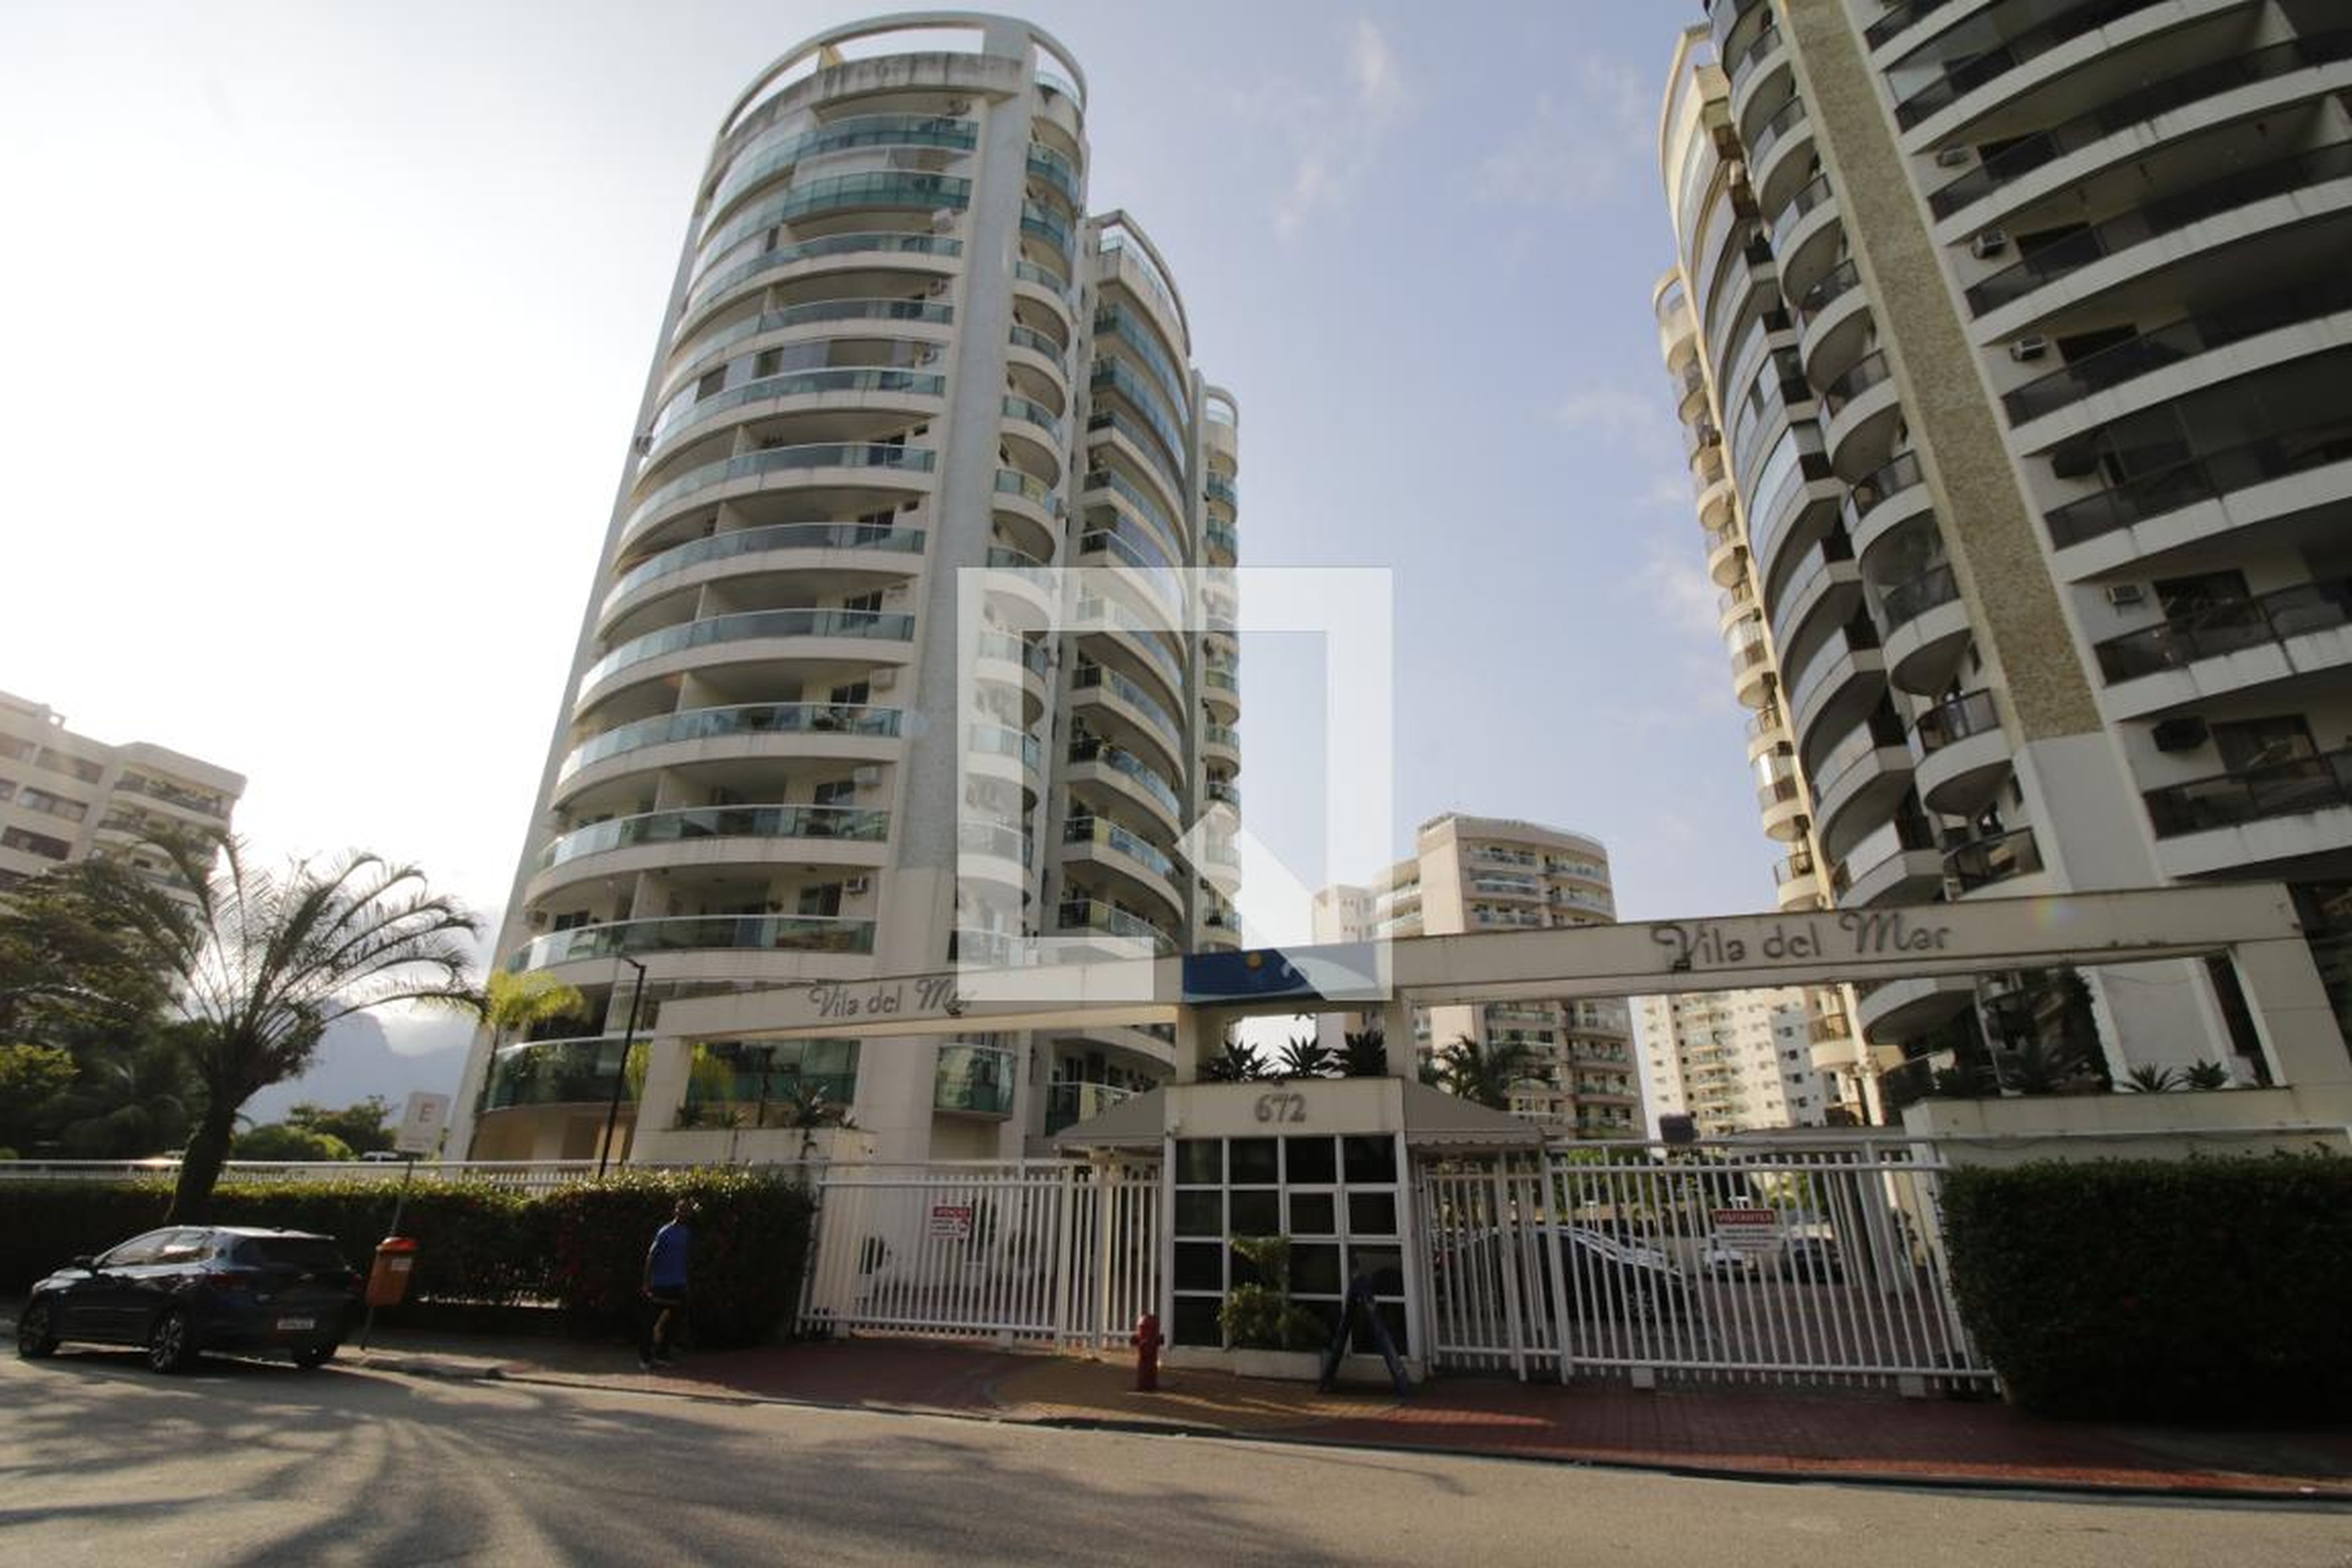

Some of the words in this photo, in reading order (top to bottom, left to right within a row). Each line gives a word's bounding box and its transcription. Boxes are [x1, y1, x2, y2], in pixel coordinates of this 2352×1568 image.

[1650, 923, 1746, 968] Vila
[1763, 922, 1822, 958] del
[1839, 912, 1951, 954] Mar
[809, 984, 858, 1017] Vila
[867, 984, 903, 1014] del
[1255, 1093, 1306, 1123] 672
